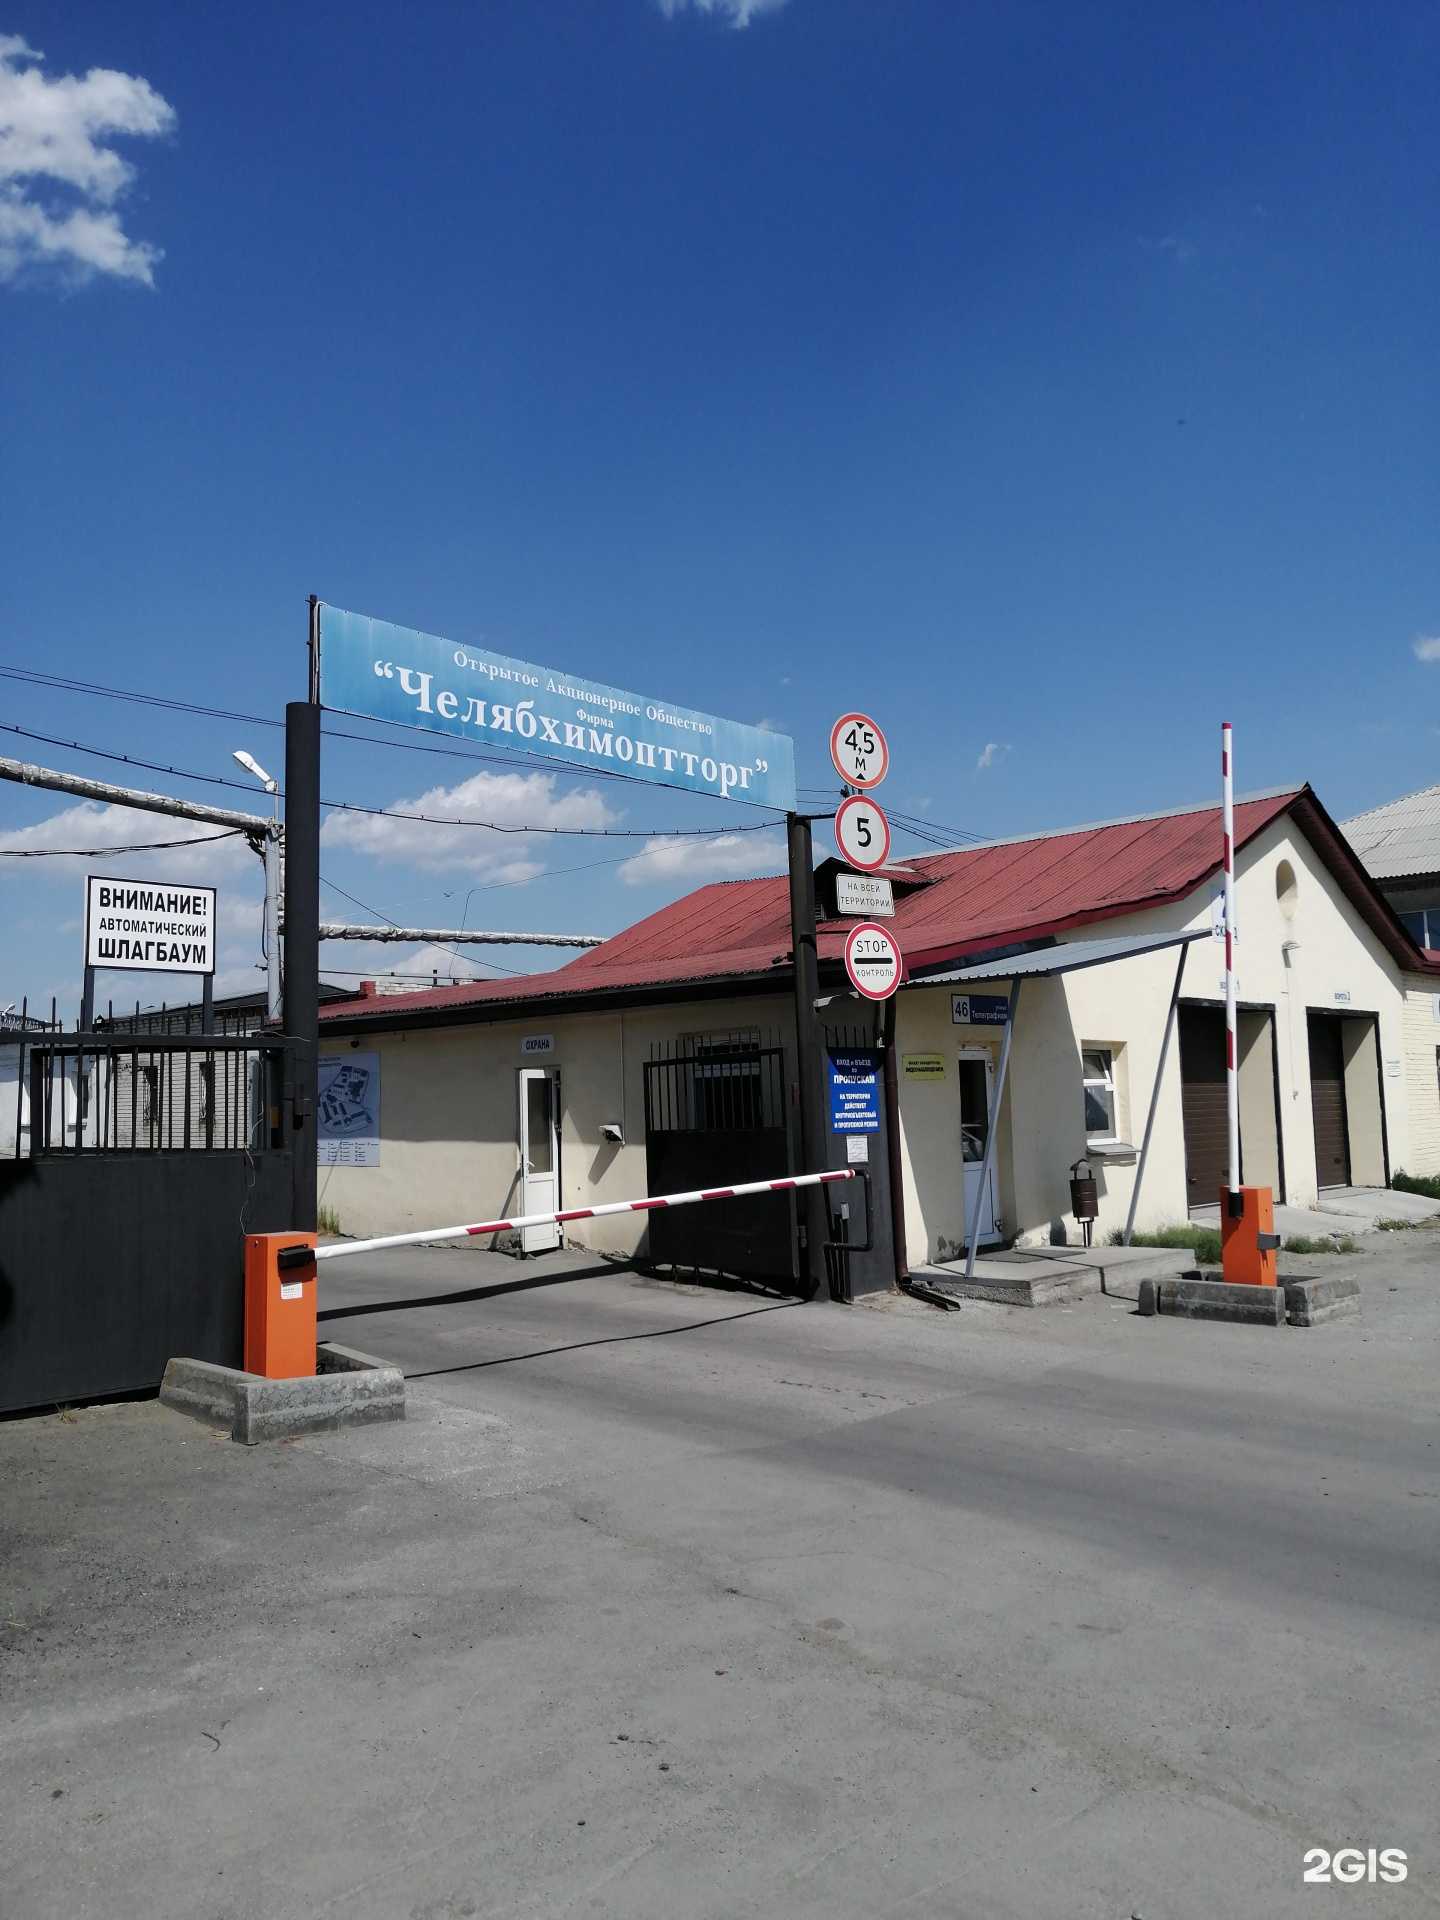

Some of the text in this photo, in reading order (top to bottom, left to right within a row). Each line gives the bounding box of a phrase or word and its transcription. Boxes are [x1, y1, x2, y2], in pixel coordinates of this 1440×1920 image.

[453, 650, 712, 736] Открытое Акционерное Общество
[576, 708, 614, 729] Фирма
[844, 729, 875, 755] 4,5
[856, 817, 872, 848] 5
[847, 882, 859, 891] НА
[99, 887, 207, 916] ВНИМАНИЕ!
[840, 896, 890, 908] ТЕРРИТОРИИ
[99, 917, 207, 938] АВТОМАТИЧЕСКИЙ
[98, 937, 206, 965] ШЛАГБАУМ
[856, 940, 888, 953] STOP
[856, 969, 894, 977] КОНТРОЛЬ
[955, 1001, 969, 1017] 46
[525, 1039, 550, 1050] ОХРАНА
[833, 1075, 875, 1084] ПРОПУСКАМ
